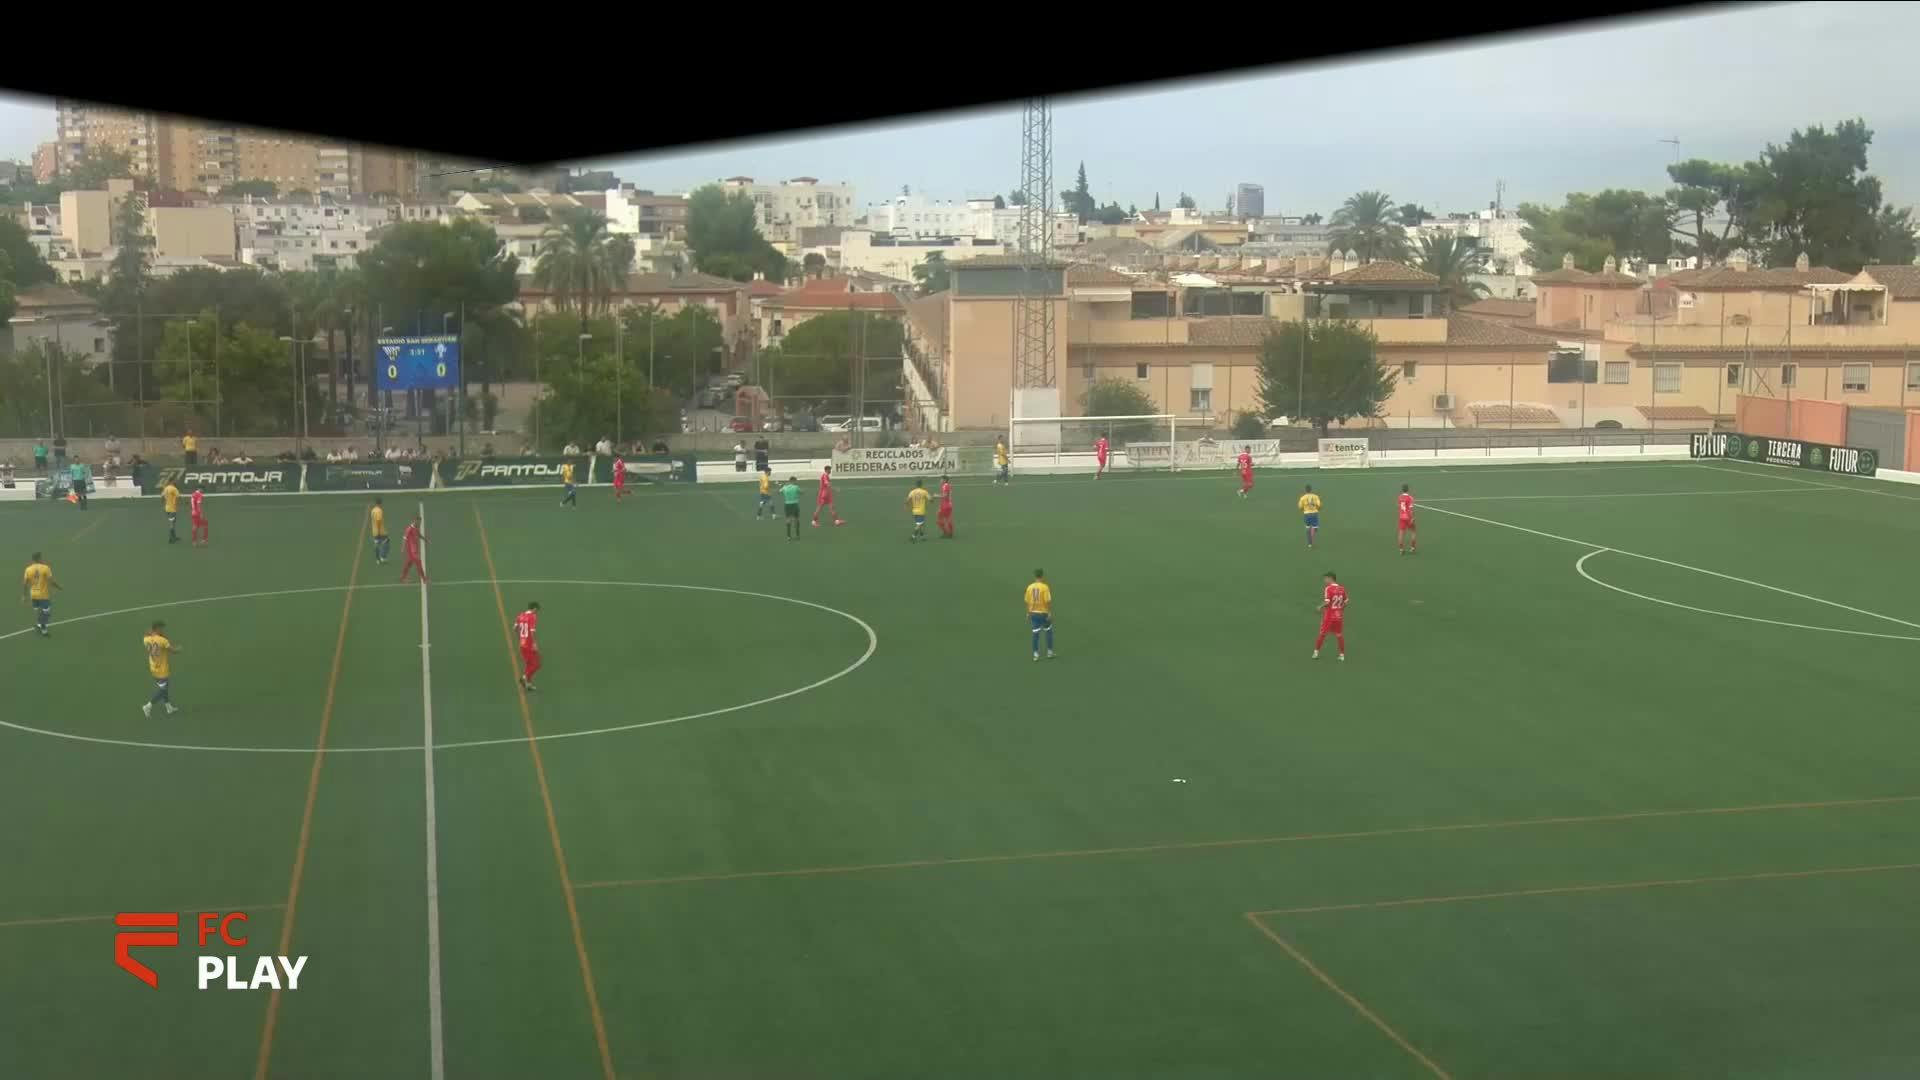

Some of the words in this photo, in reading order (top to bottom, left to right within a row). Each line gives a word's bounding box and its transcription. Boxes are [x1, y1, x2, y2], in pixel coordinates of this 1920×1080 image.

[388, 364, 398, 378] 0
[436, 362, 446, 377] 0
[865, 450, 924, 459] RECICLADOS
[1768, 440, 1802, 459] TERCERA
[835, 462, 897, 473] HEREDERAS
[184, 471, 283, 484] PANTOJA
